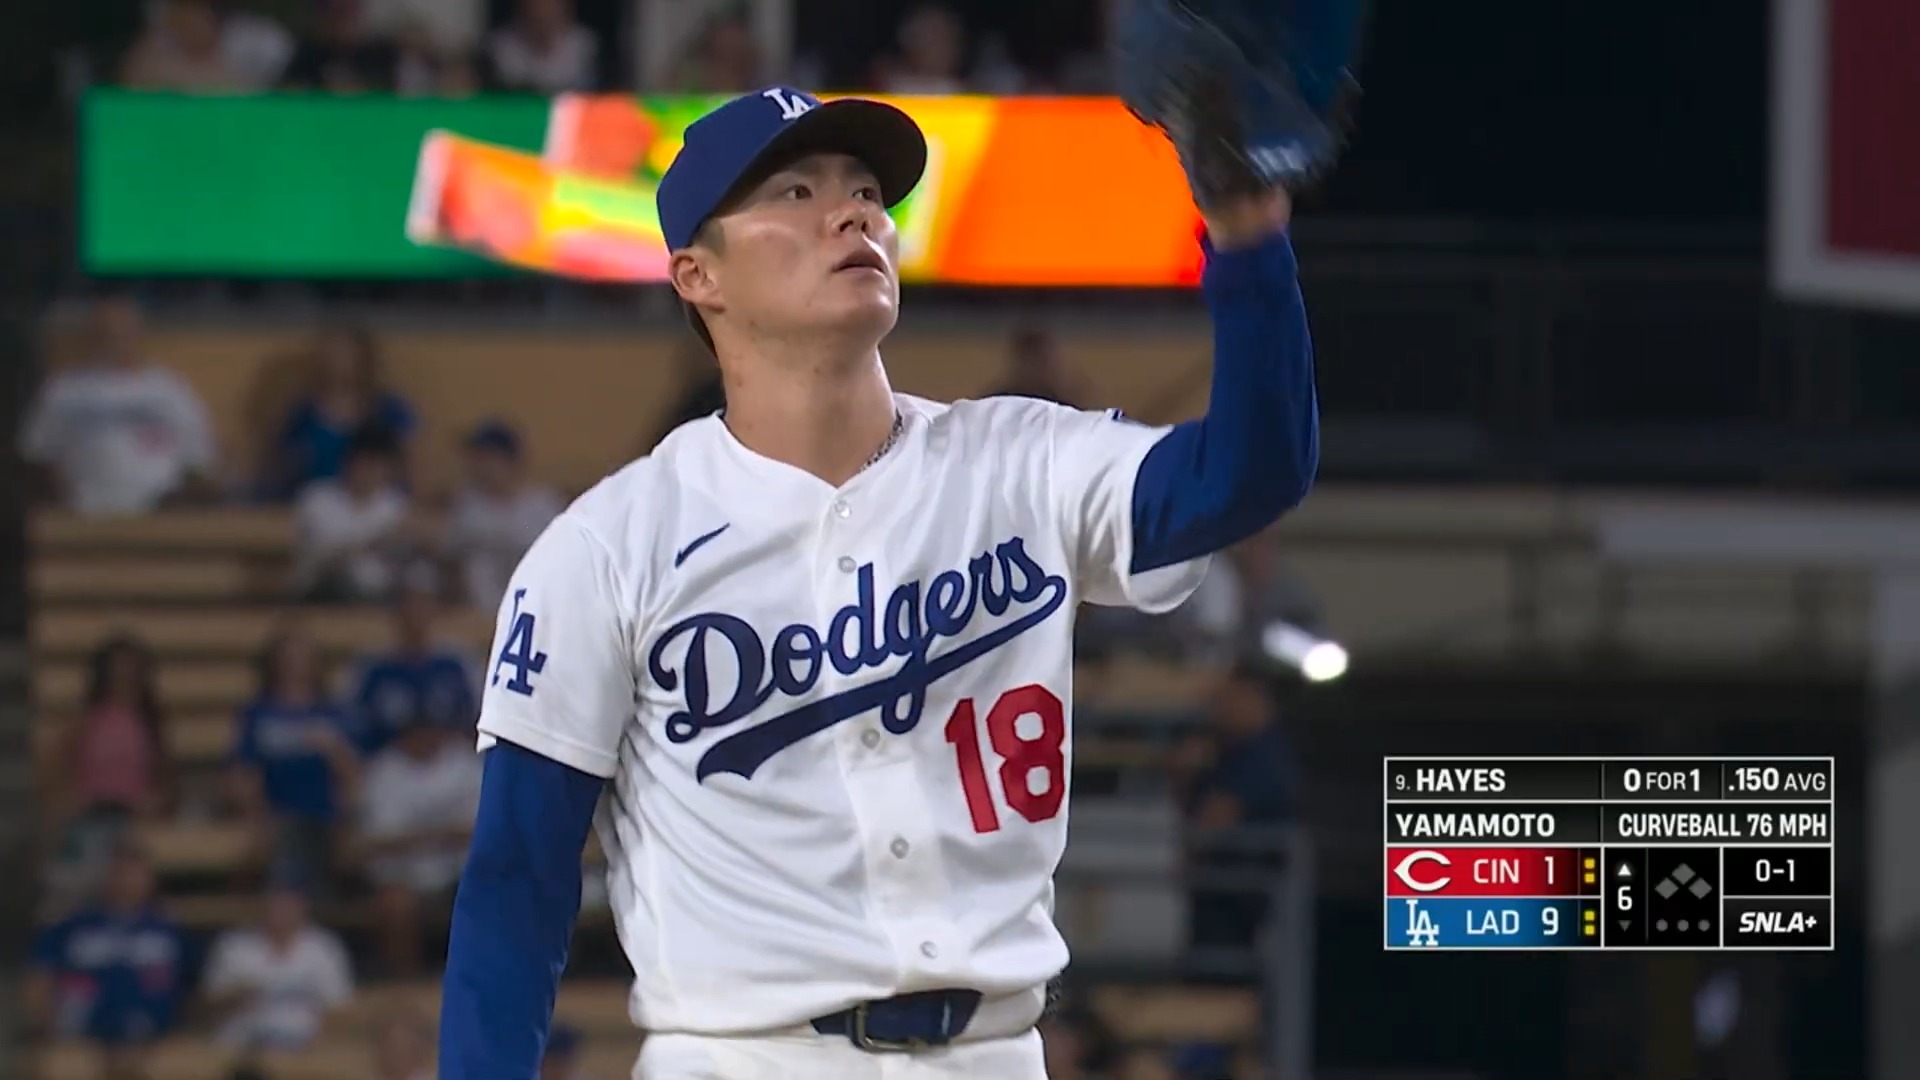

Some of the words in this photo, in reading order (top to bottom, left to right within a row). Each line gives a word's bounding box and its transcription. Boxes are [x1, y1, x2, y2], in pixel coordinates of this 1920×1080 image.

[763, 87, 813, 119] LA
[650, 537, 1066, 744] Dodgers
[944, 683, 1065, 834] 18
